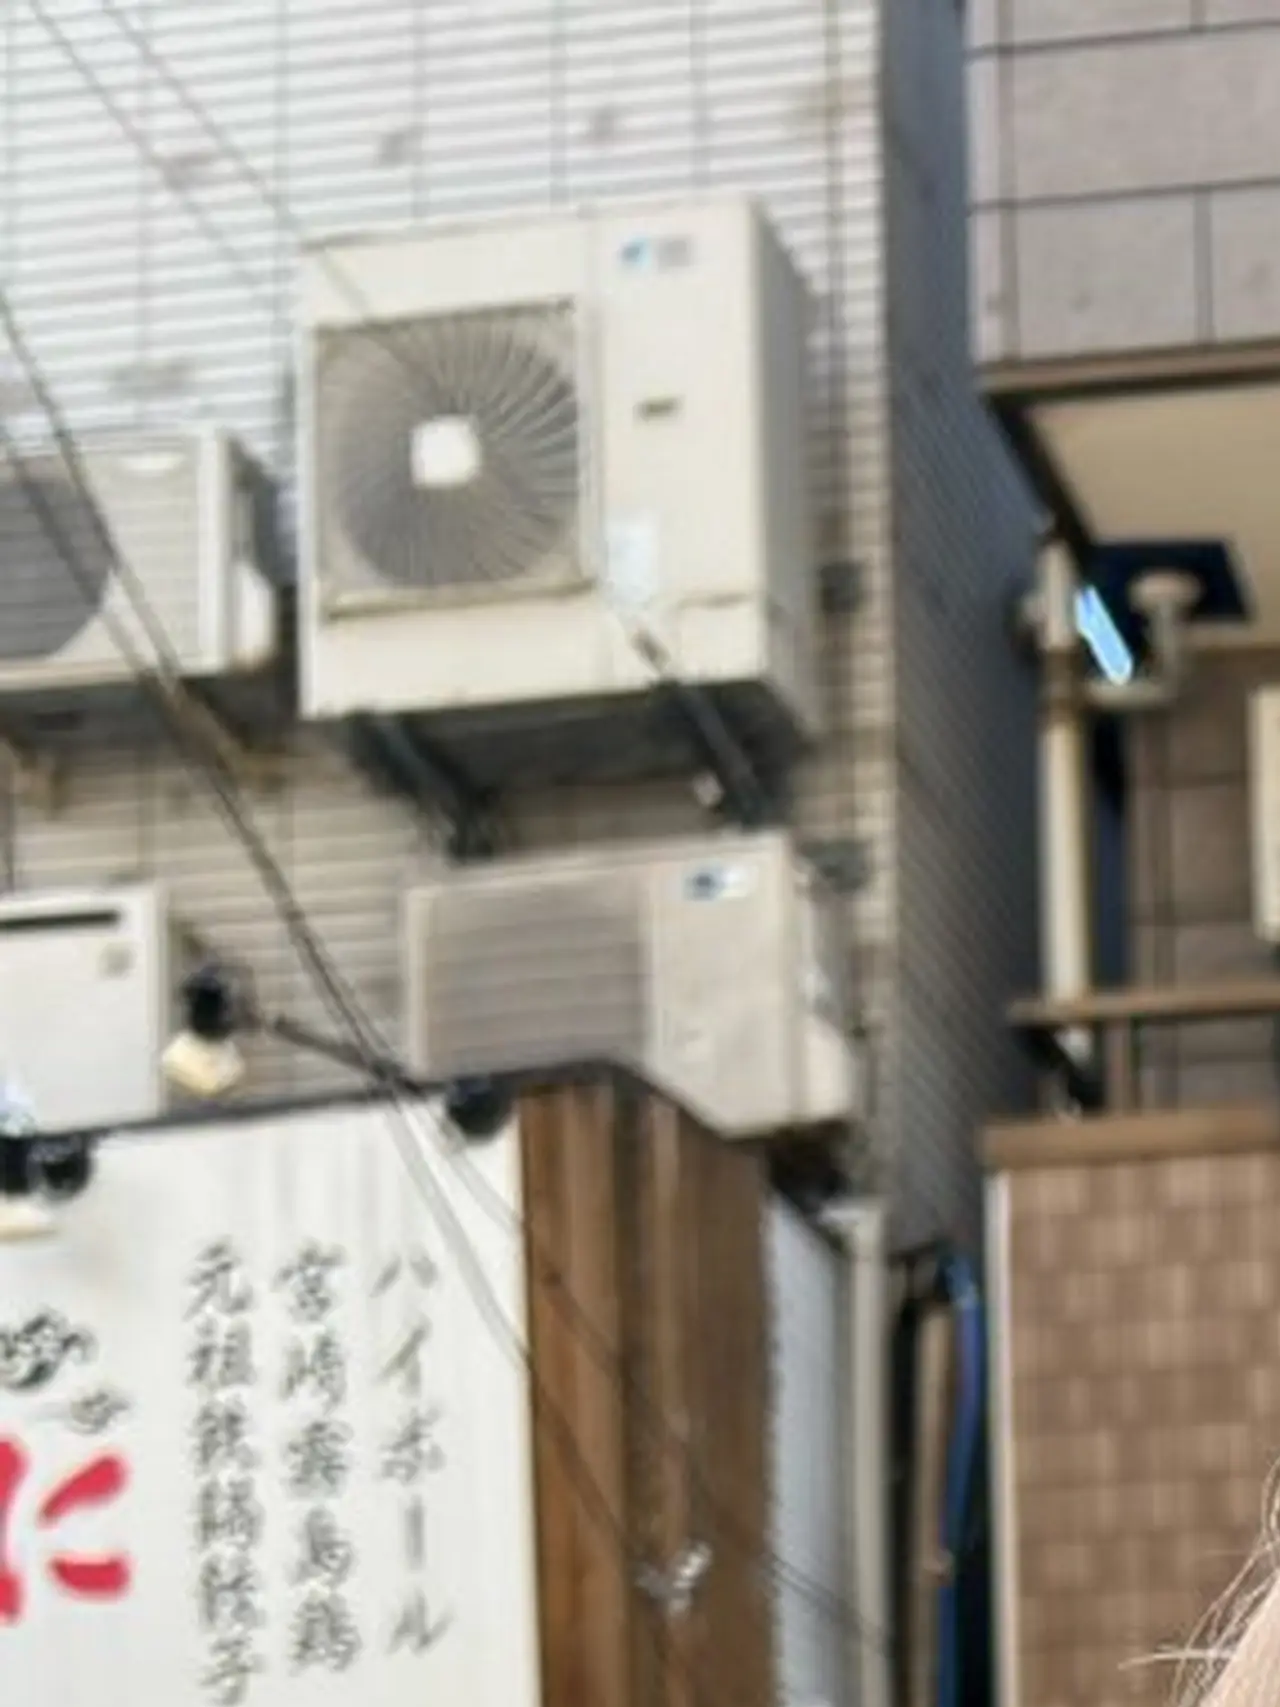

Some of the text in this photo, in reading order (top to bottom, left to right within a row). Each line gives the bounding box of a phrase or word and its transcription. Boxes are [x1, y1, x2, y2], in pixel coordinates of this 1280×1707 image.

[370, 1246, 452, 1656] ハイボール
